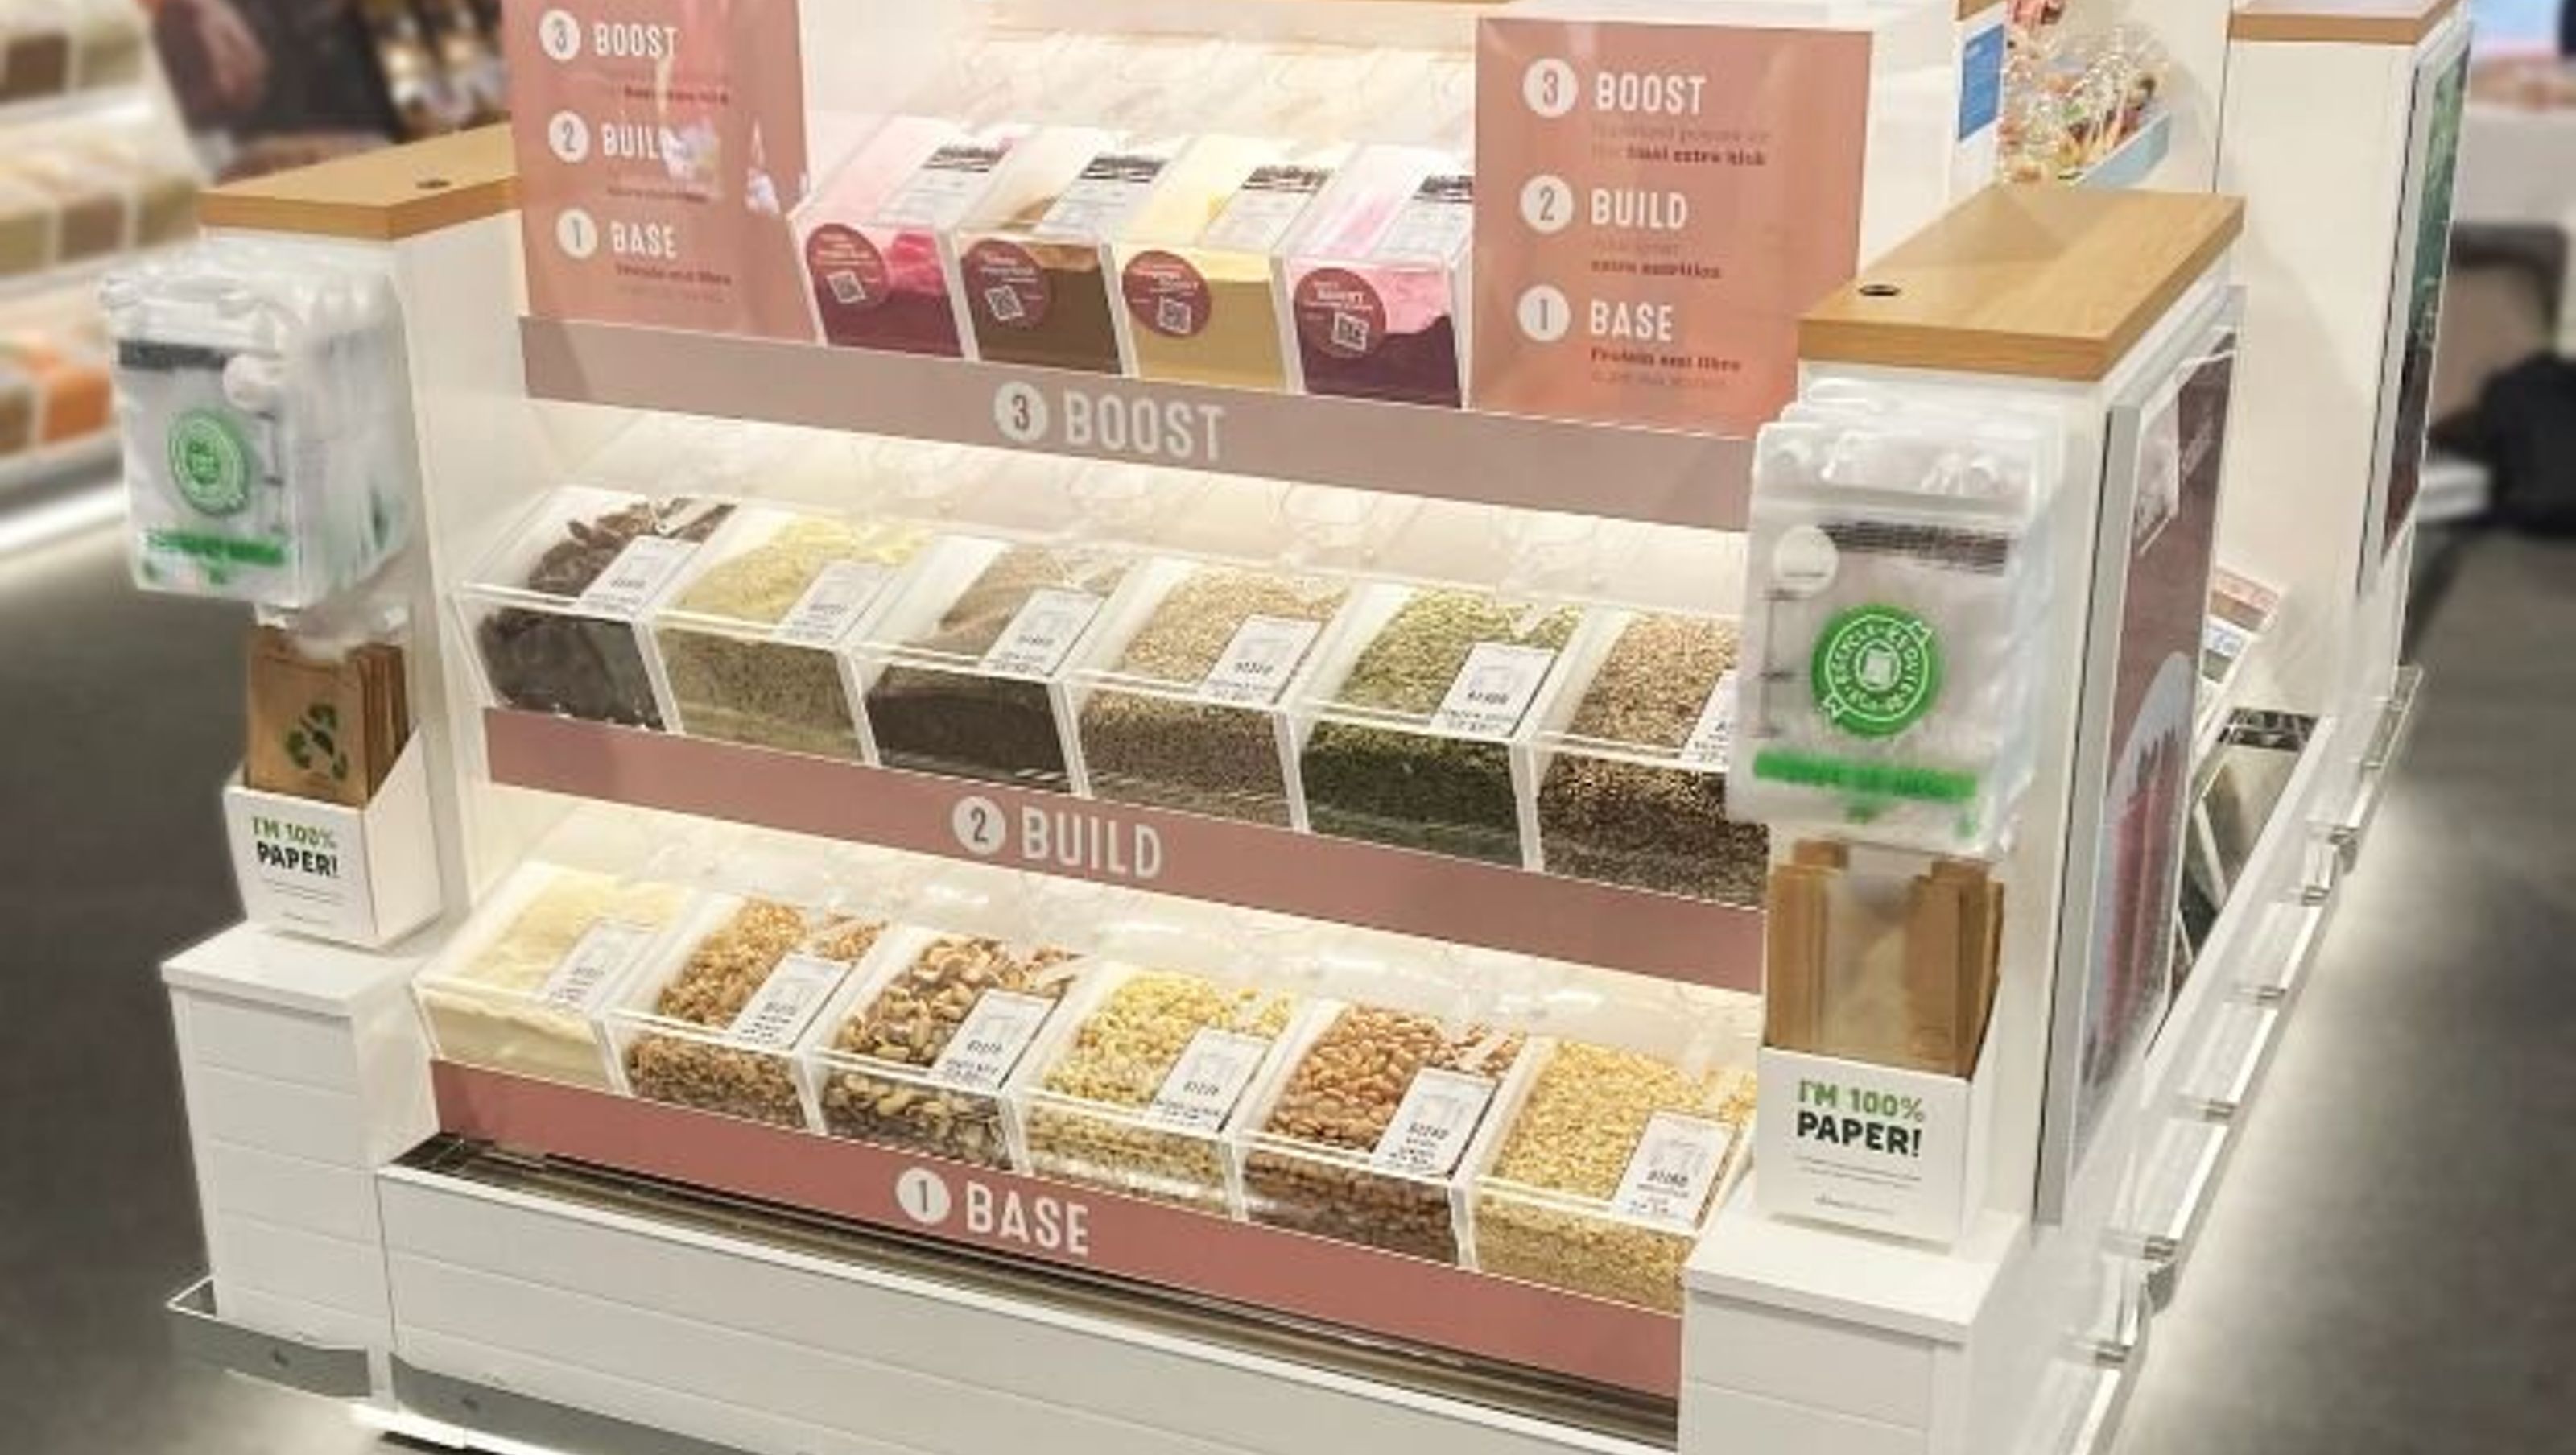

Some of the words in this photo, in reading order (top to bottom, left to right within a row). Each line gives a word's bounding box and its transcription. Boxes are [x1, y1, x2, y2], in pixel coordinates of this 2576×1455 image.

[593, 23, 678, 59] BOOST
[1595, 72, 1707, 114] BOOST
[601, 123, 679, 161] BUIL
[1591, 188, 1688, 229] BUILD
[610, 221, 677, 258] BASE
[1591, 300, 1674, 342] BASE
[1063, 389, 1225, 461] BOOST
[285, 823, 337, 849] 100%
[1022, 806, 1162, 879] BUILD
[257, 841, 341, 878] PAPER!
[1798, 1079, 1837, 1108] I'M
[1850, 1088, 1925, 1123] 100%
[1797, 1110, 1922, 1159] PAPER!
[967, 1180, 1088, 1256] BASE
